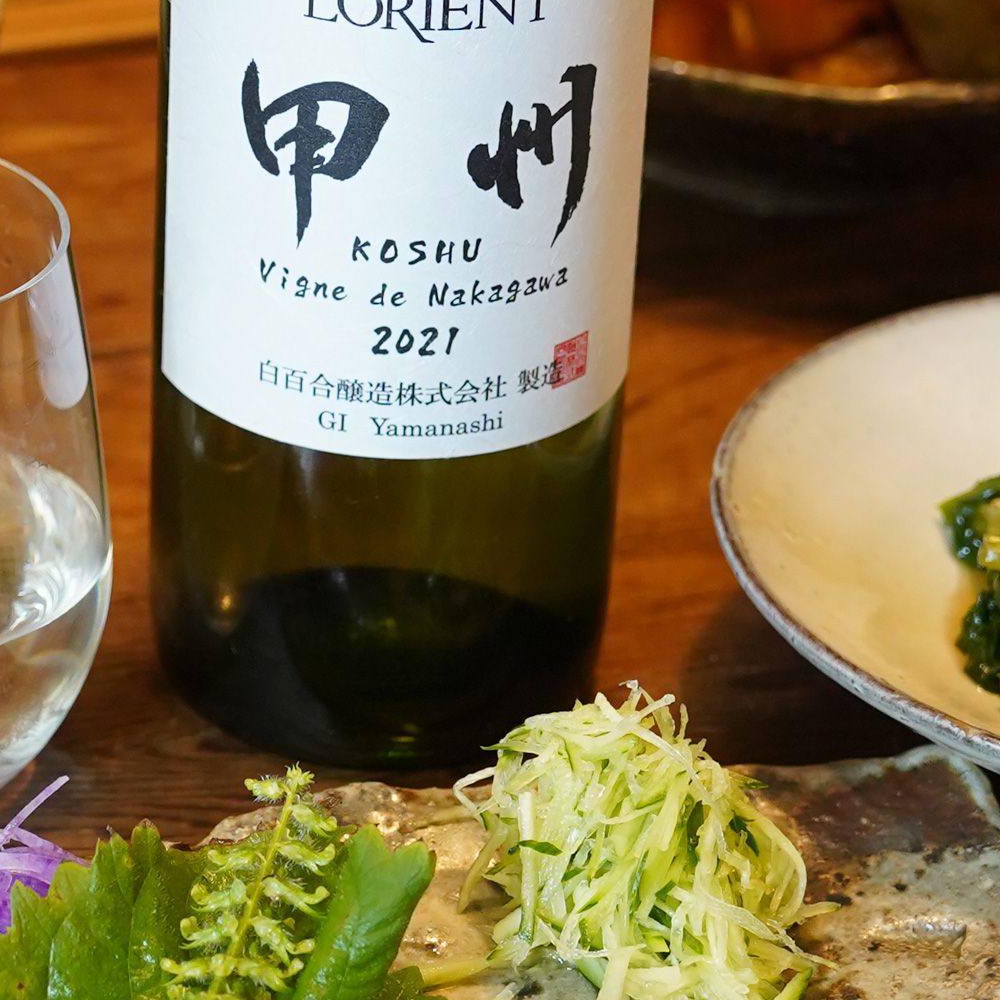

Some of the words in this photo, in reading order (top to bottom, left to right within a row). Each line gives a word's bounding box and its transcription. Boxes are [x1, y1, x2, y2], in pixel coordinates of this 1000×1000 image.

[351, 236, 484, 265] KOSHU
[258, 257, 349, 302] Vigne
[369, 283, 408, 307] de
[428, 265, 569, 308] Nakagawa
[370, 325, 460, 357] 2021
[318, 410, 348, 432] GI
[369, 410, 504, 437] Yamanashi
